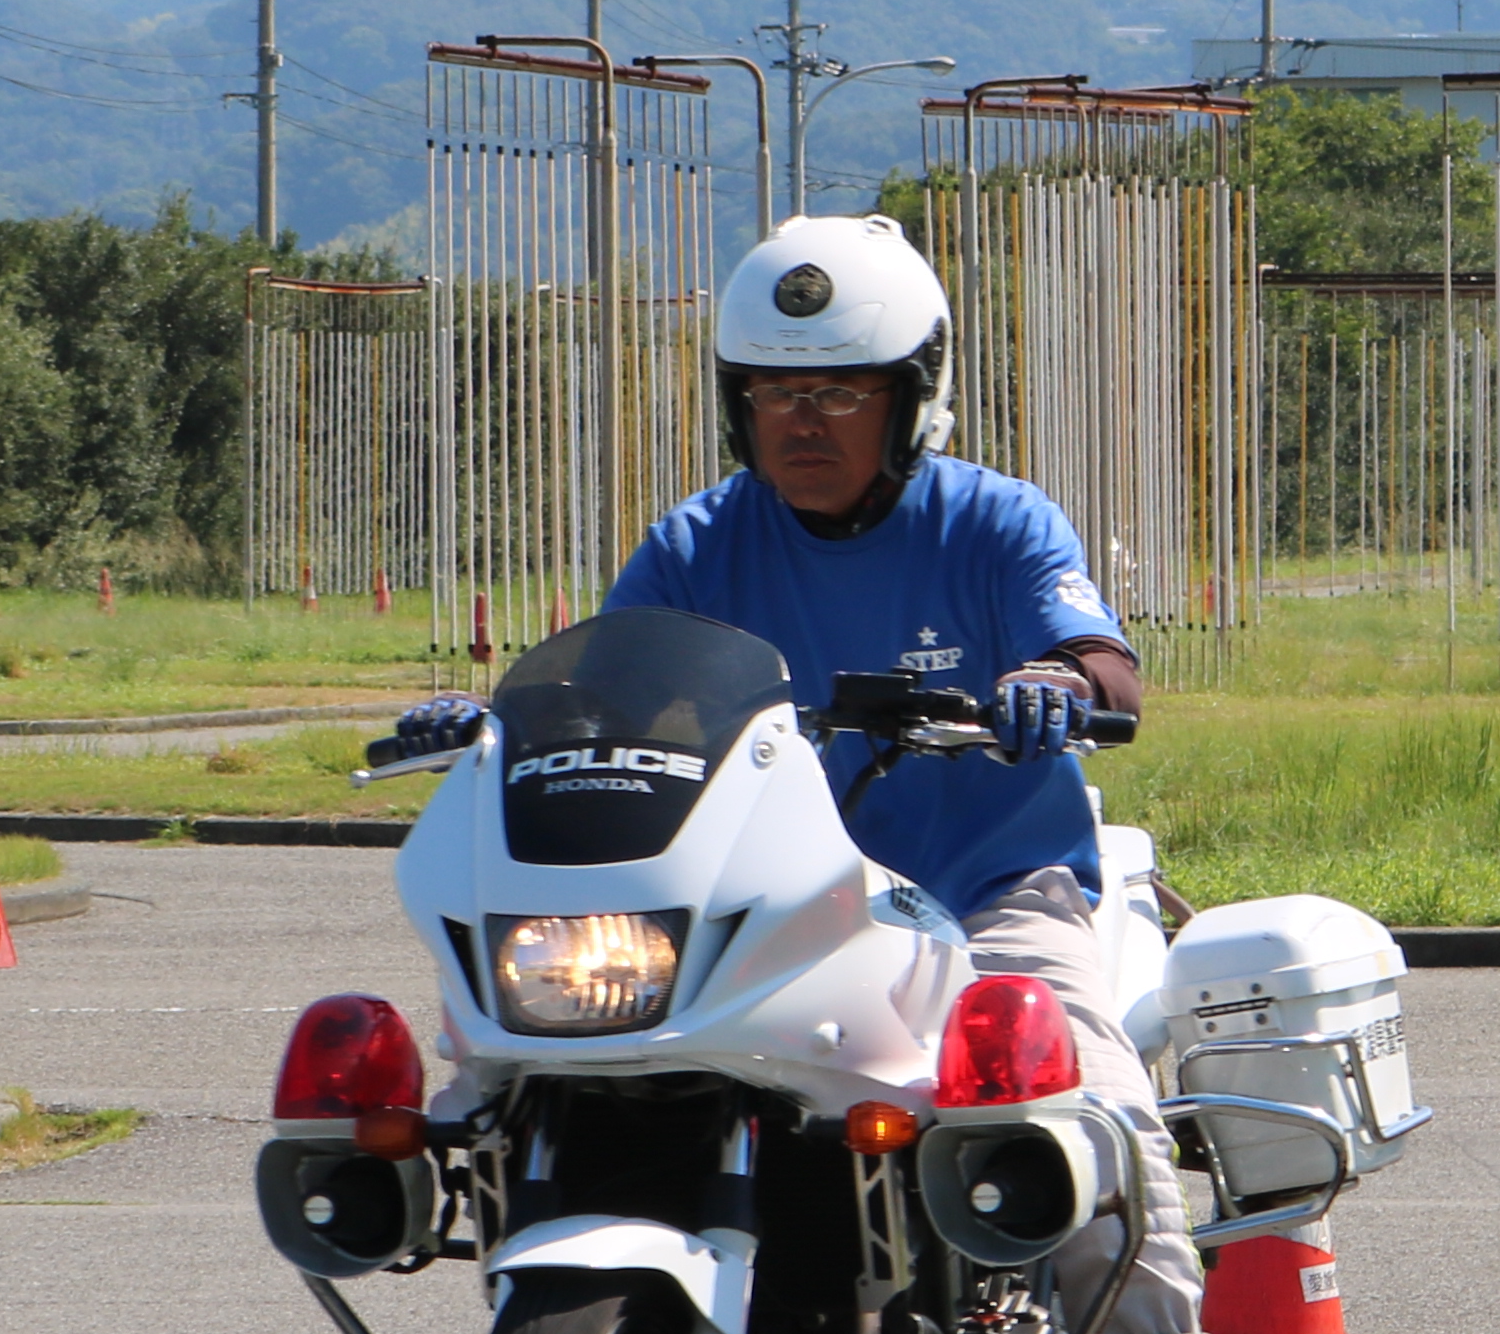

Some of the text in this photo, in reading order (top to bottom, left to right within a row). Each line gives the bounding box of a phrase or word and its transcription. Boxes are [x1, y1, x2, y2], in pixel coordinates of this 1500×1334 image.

[900, 647, 964, 672] STEP
[507, 747, 706, 784] POLICE
[544, 778, 654, 794] HONDA
